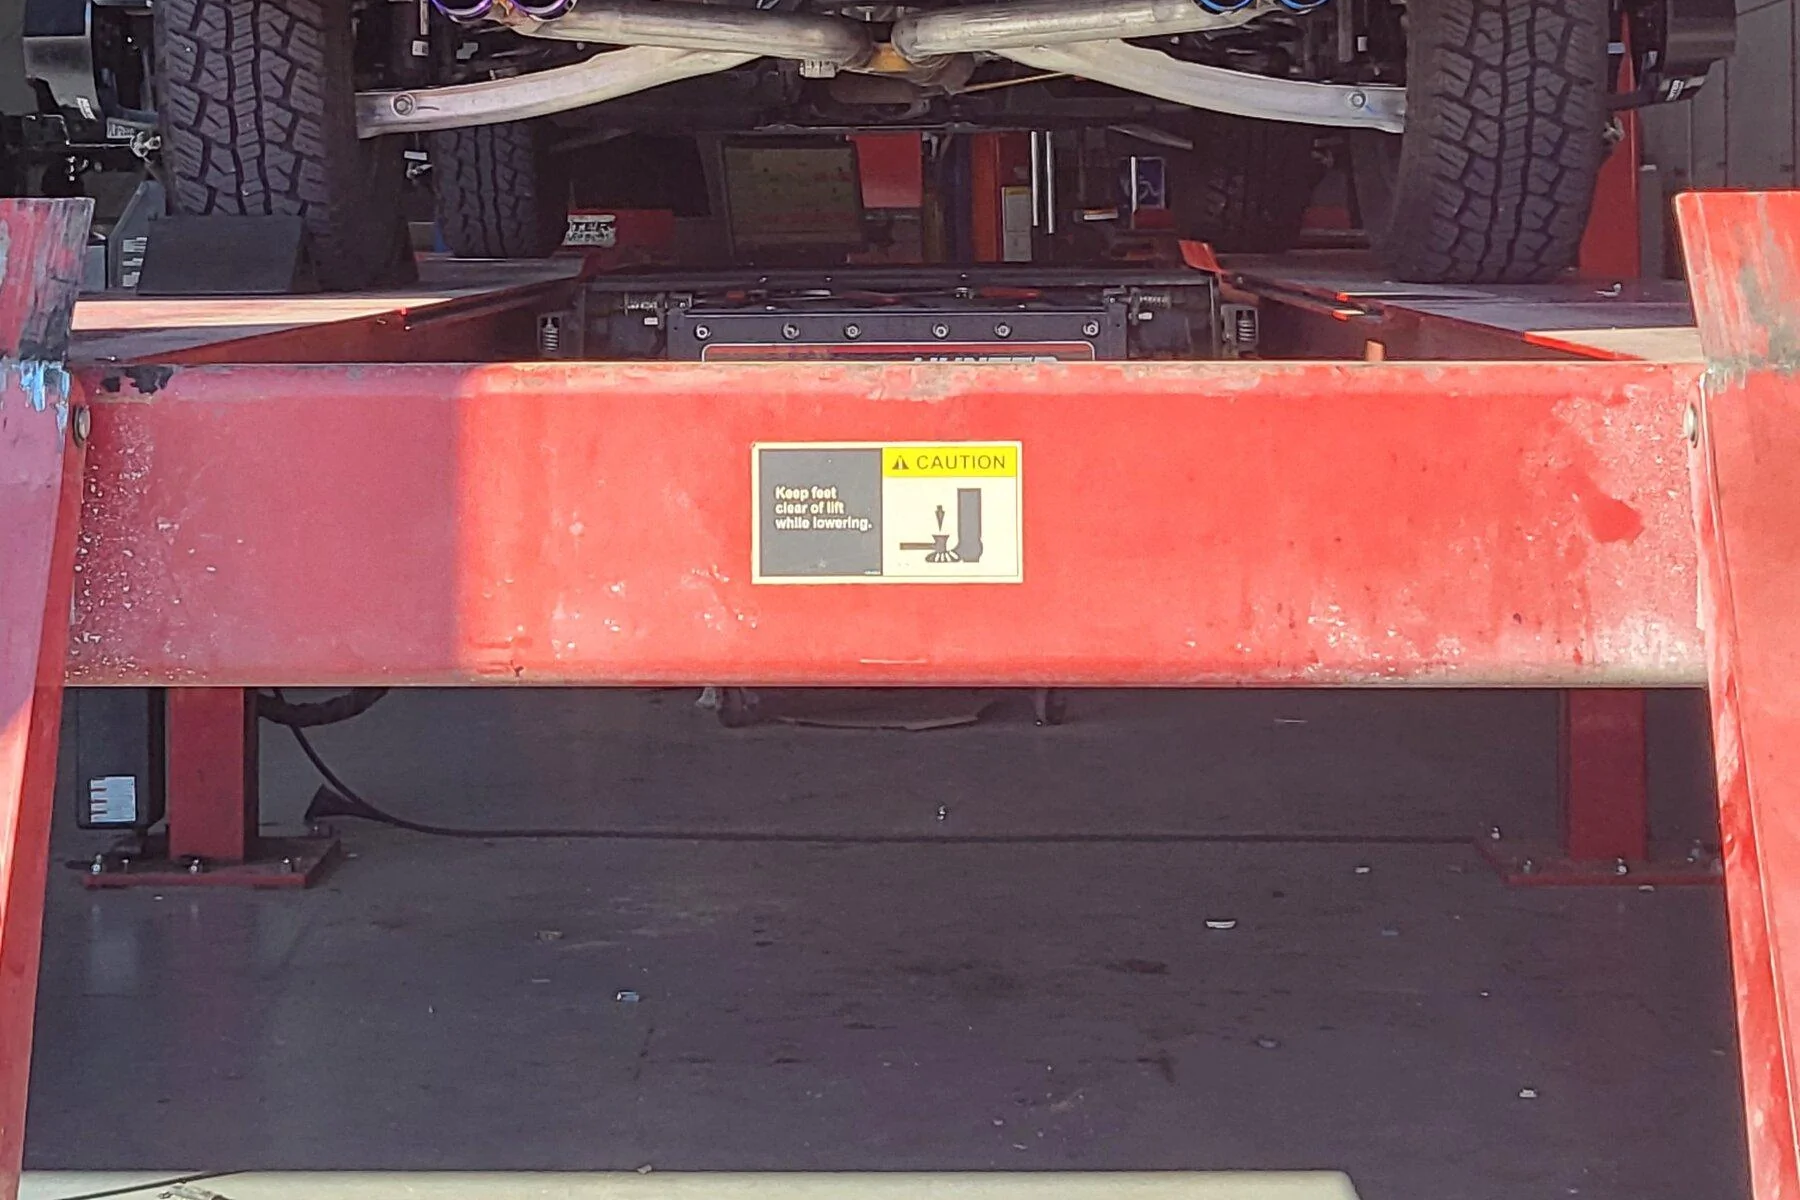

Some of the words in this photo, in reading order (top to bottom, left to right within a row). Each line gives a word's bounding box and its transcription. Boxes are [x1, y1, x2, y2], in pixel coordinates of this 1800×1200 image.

[916, 455, 1006, 469] CAUTION
[775, 486, 809, 502] Keep
[811, 486, 837, 500] feet
[775, 501, 808, 514] clear
[810, 501, 824, 514] of
[826, 501, 845, 514] lift
[775, 516, 810, 529] while
[812, 516, 872, 531] lowering.
